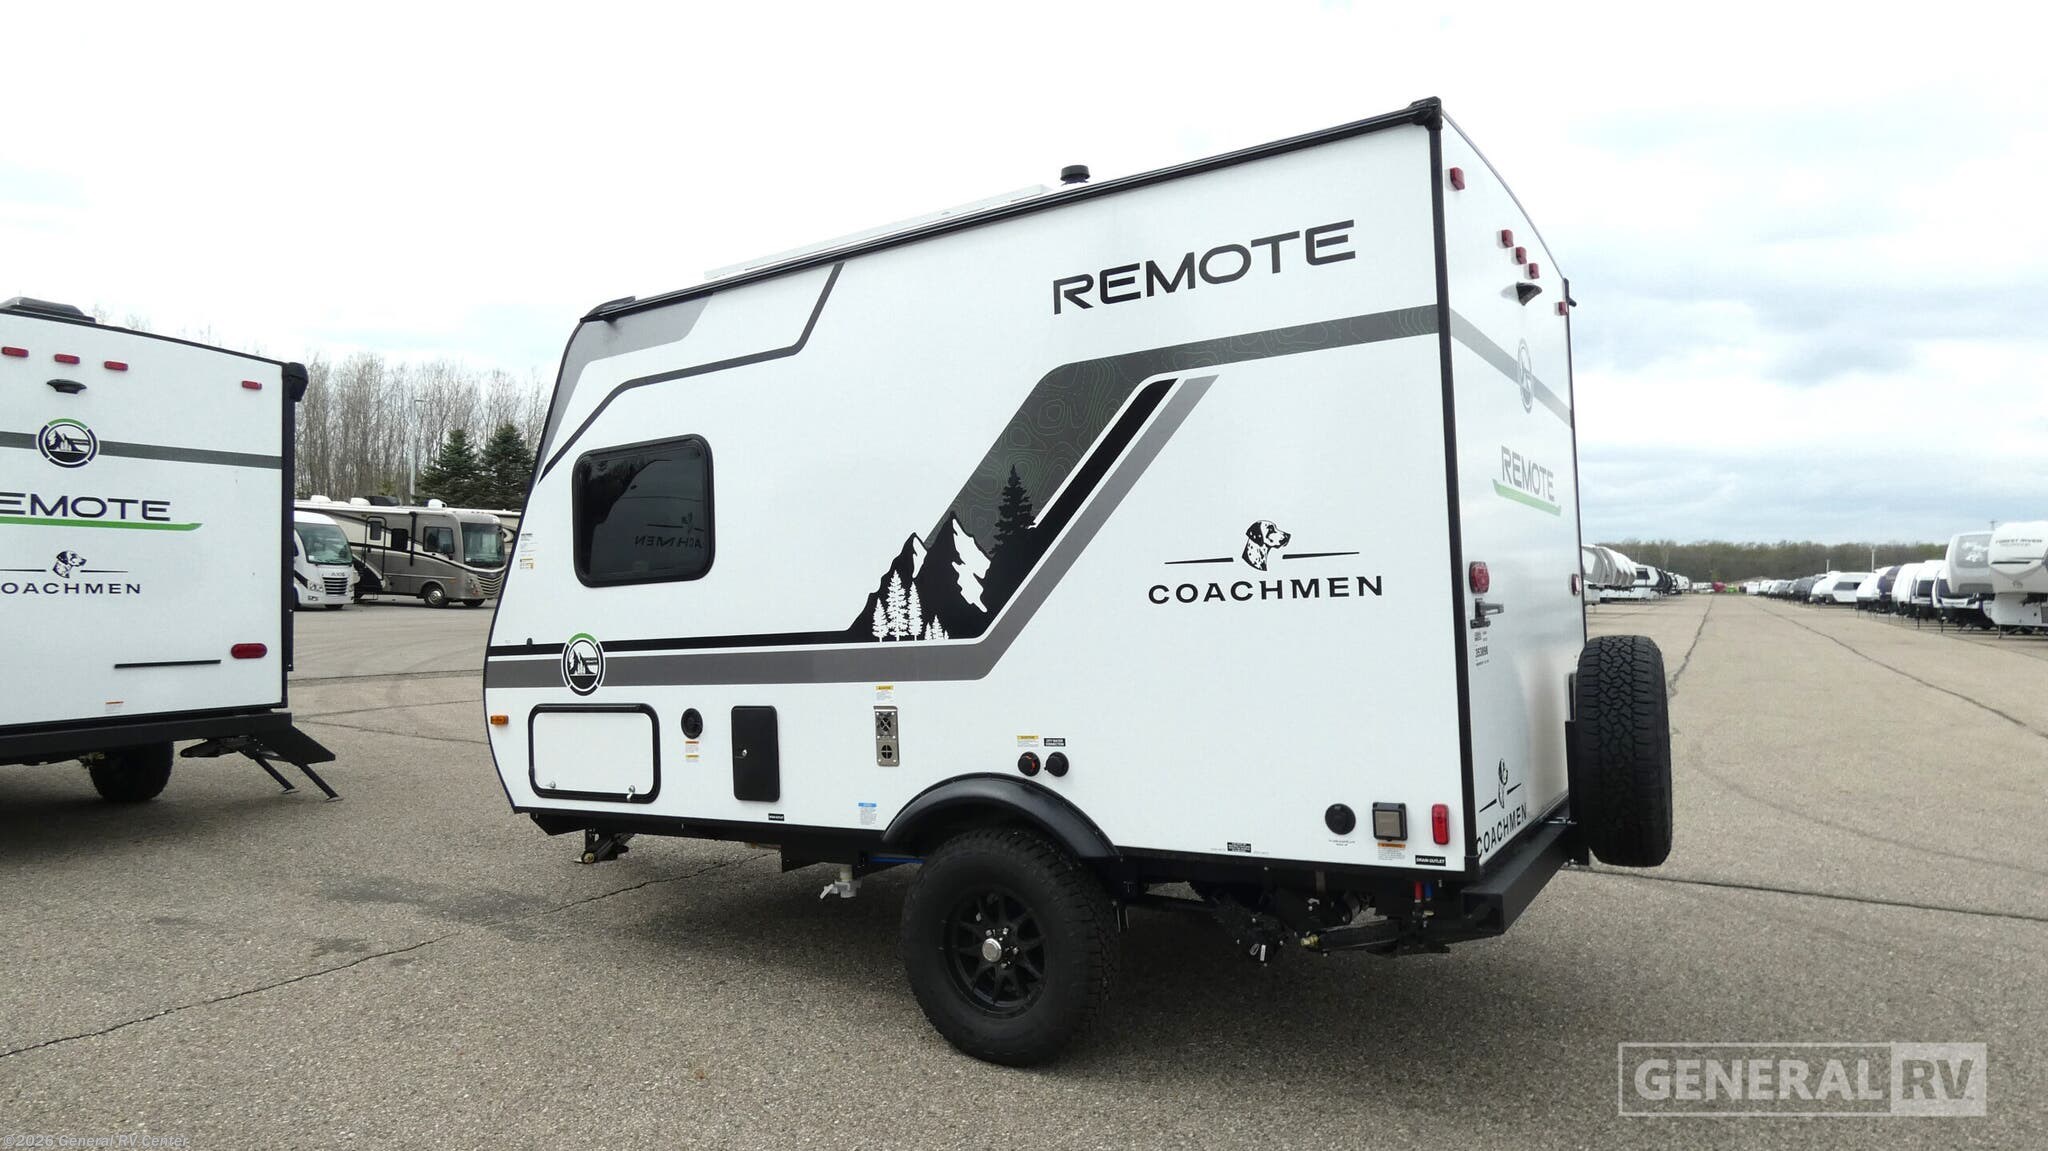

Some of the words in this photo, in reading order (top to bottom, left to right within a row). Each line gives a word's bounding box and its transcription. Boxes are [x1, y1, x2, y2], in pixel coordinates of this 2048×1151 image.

[1052, 219, 1356, 315] REMOTE
[1501, 446, 1555, 502] REMOTE
[1, 582, 141, 595] OACHMEN
[1148, 575, 1383, 605] COACHMEN
[1477, 803, 1527, 858] COACHMEN
